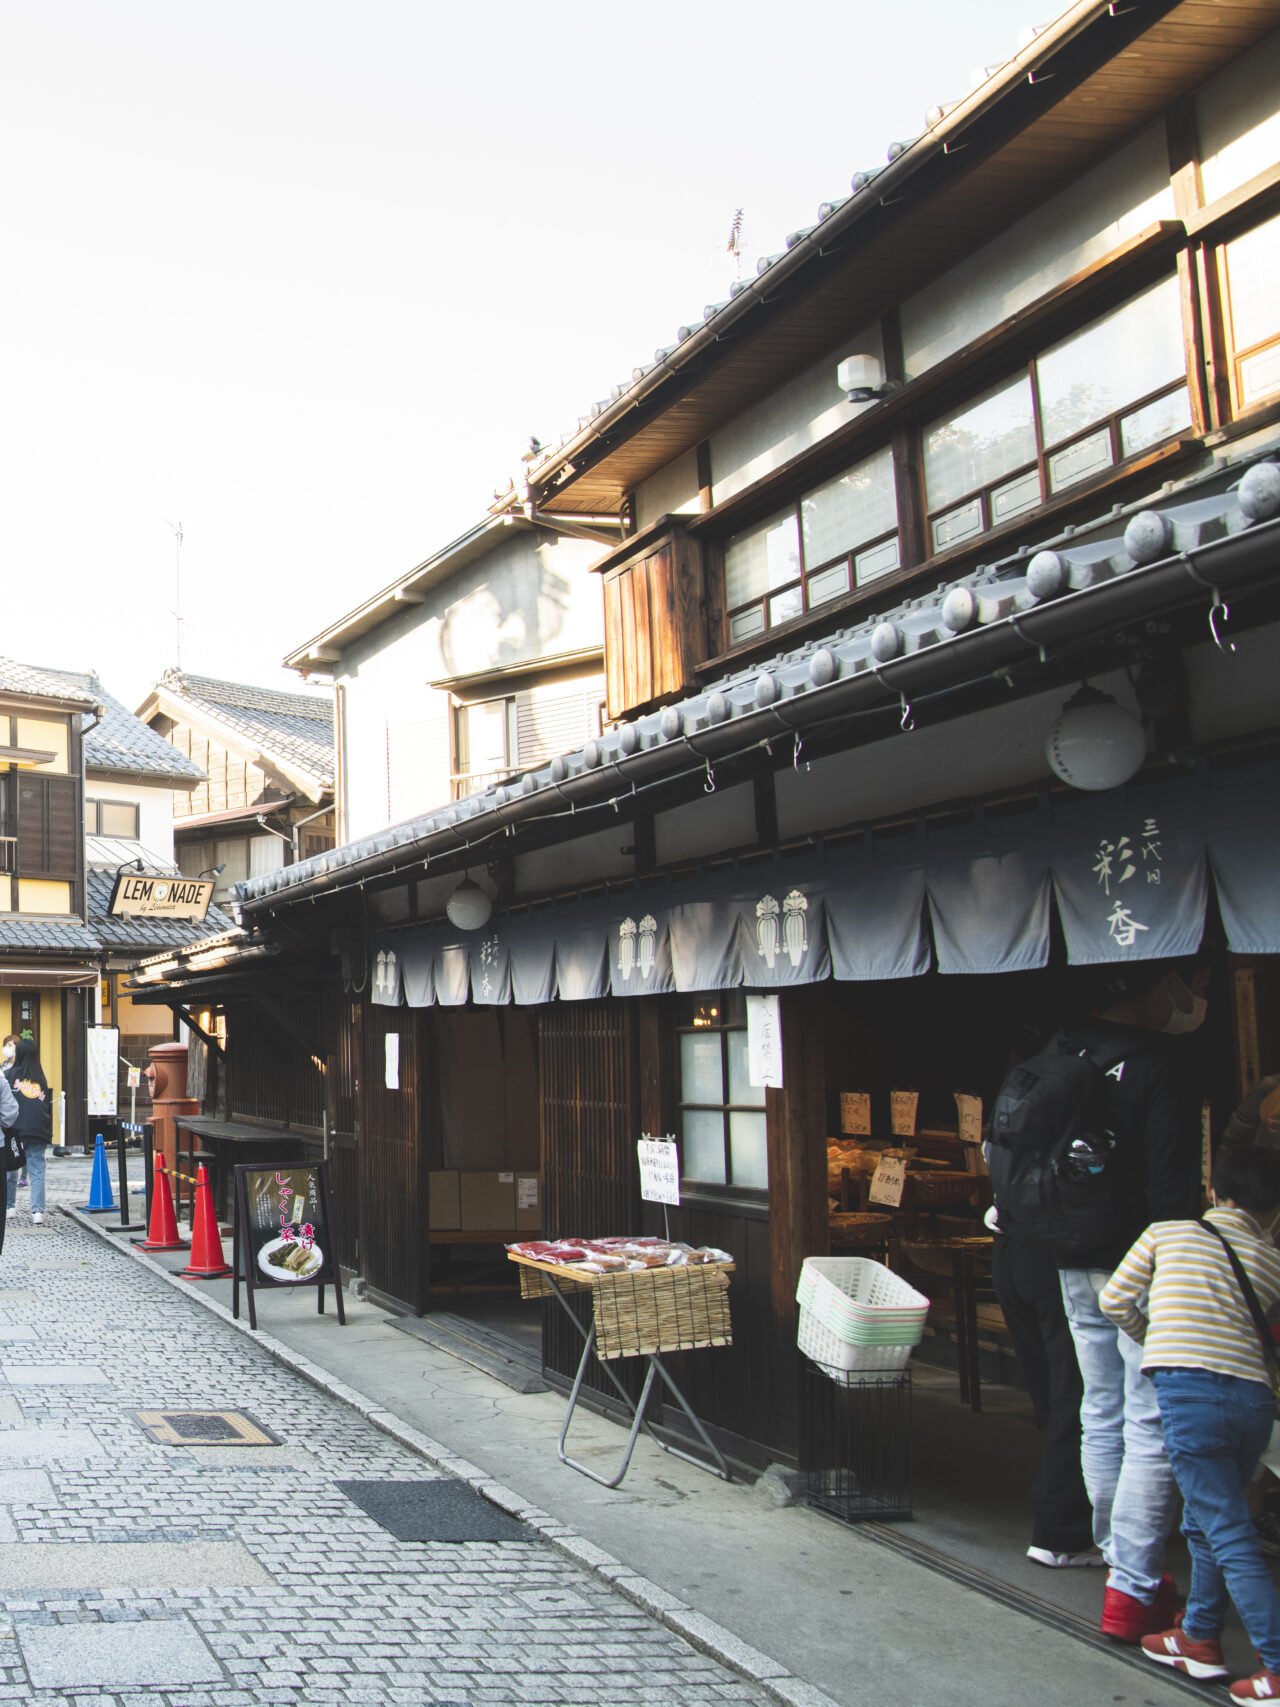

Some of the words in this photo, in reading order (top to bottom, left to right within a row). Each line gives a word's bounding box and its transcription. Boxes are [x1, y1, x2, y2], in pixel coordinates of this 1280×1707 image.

[1141, 818, 1162, 885] 三代目
[1091, 836, 1150, 946] 彩香
[275, 1172, 297, 1242] しゃくし菜
[298, 1222, 316, 1251] 漬け
